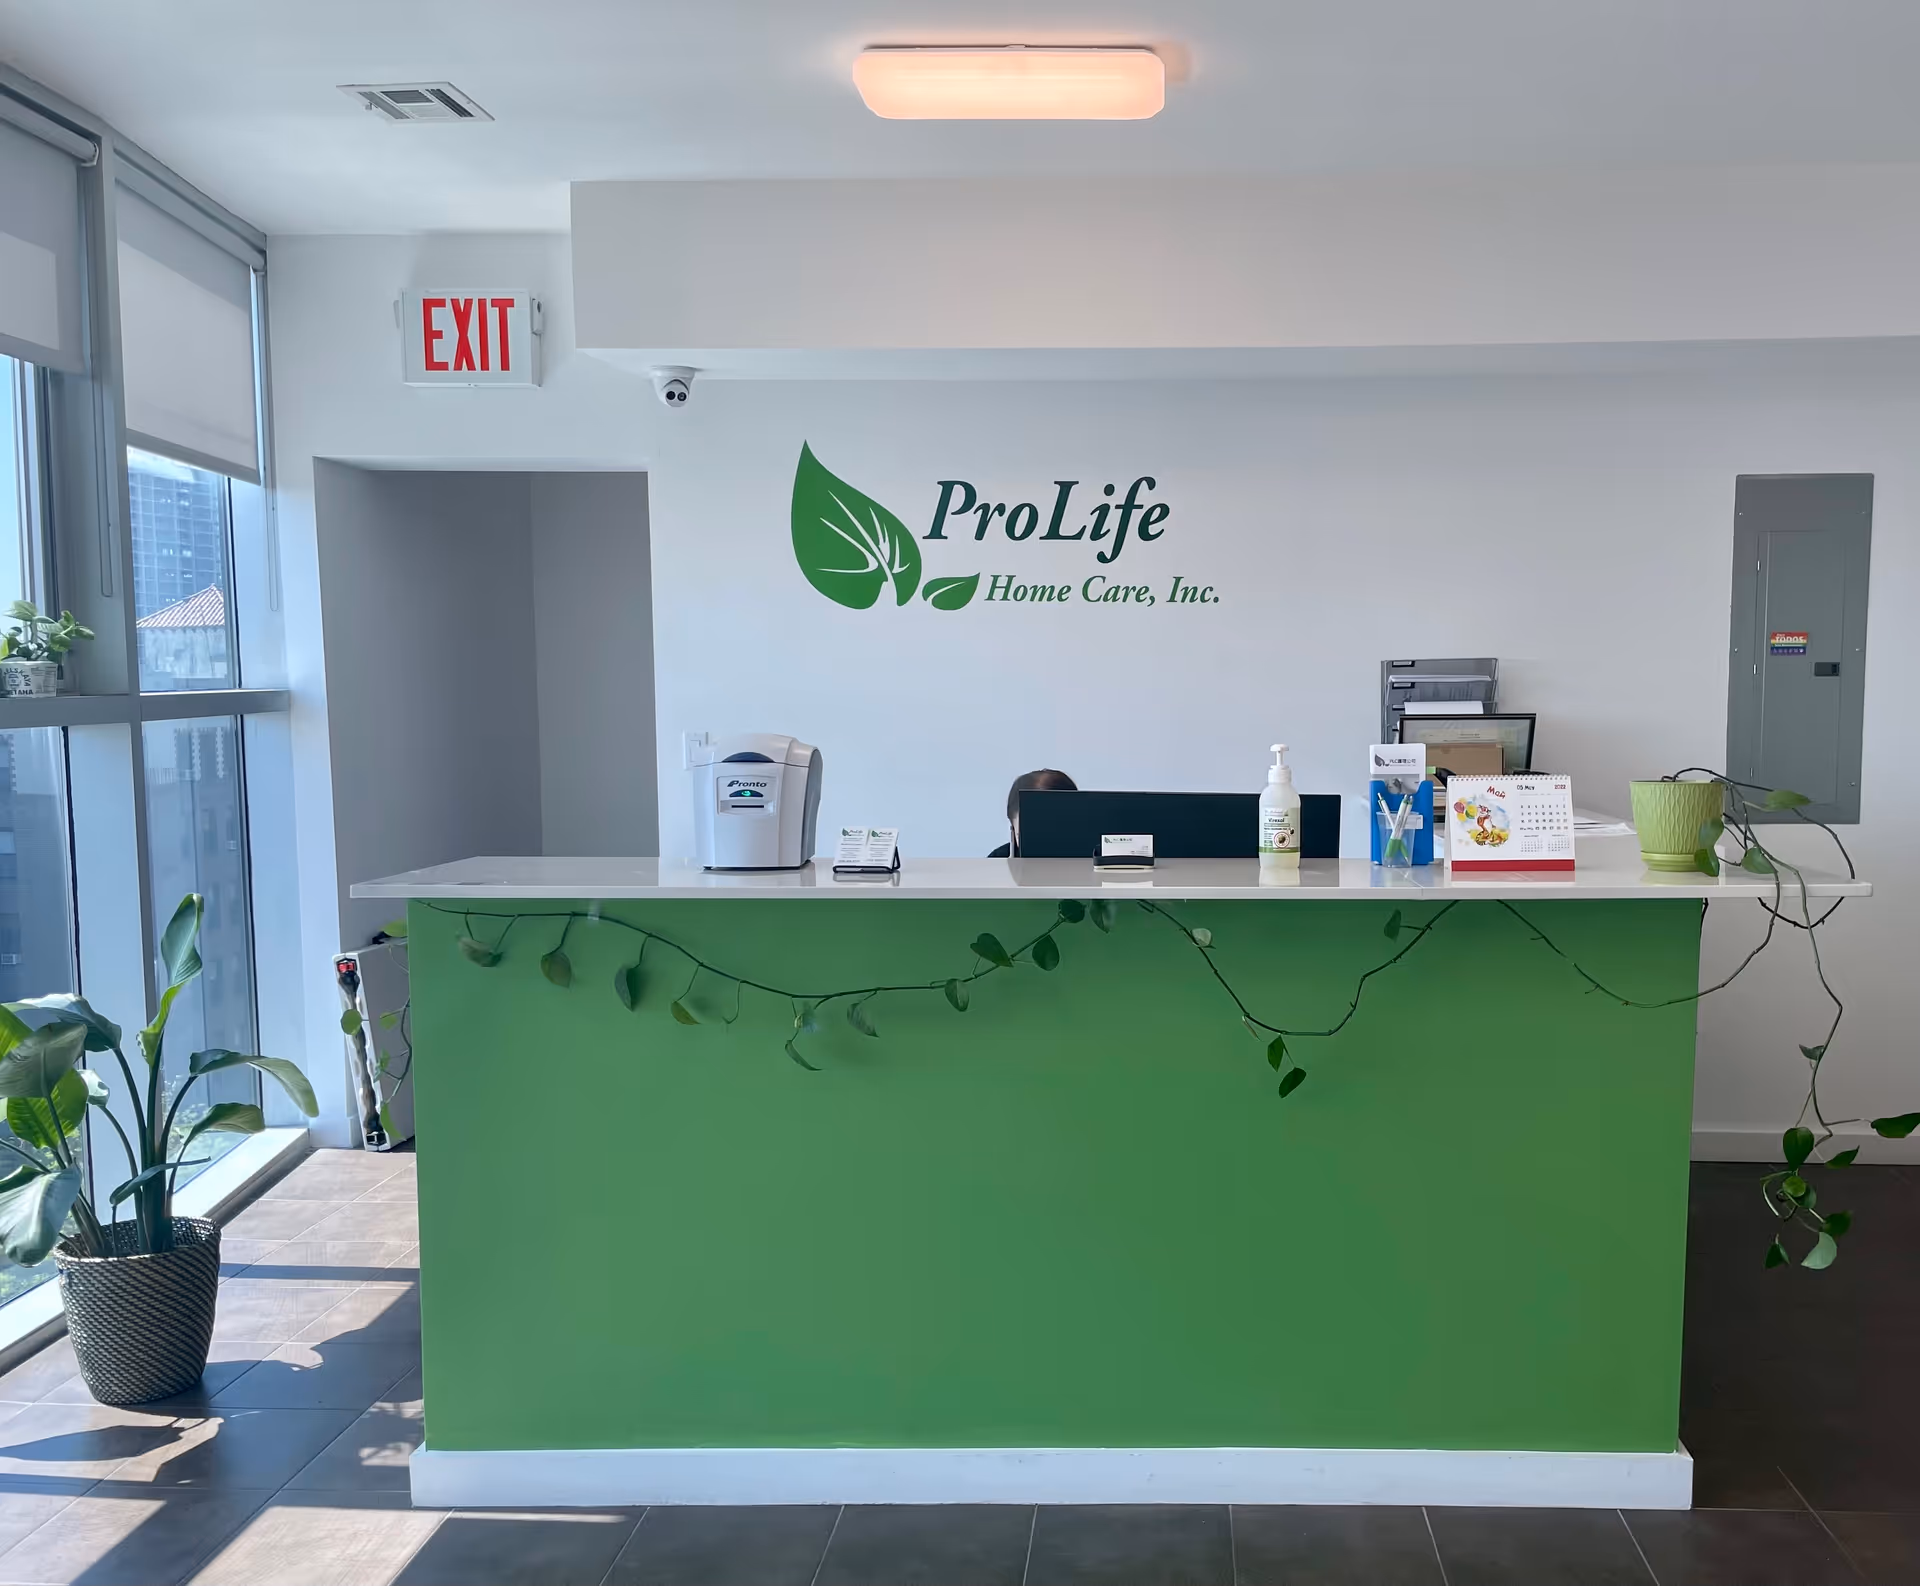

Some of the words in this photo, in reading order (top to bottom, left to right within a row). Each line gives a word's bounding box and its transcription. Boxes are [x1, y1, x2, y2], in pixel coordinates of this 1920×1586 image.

[422, 298, 515, 372] EXIT
[922, 476, 1170, 564] ProLife
[985, 574, 1070, 602] Home
[1081, 575, 1156, 606] Care,
[1166, 576, 1220, 603] Inc.
[727, 780, 768, 788] Pronto
[1487, 785, 1506, 799] Май
